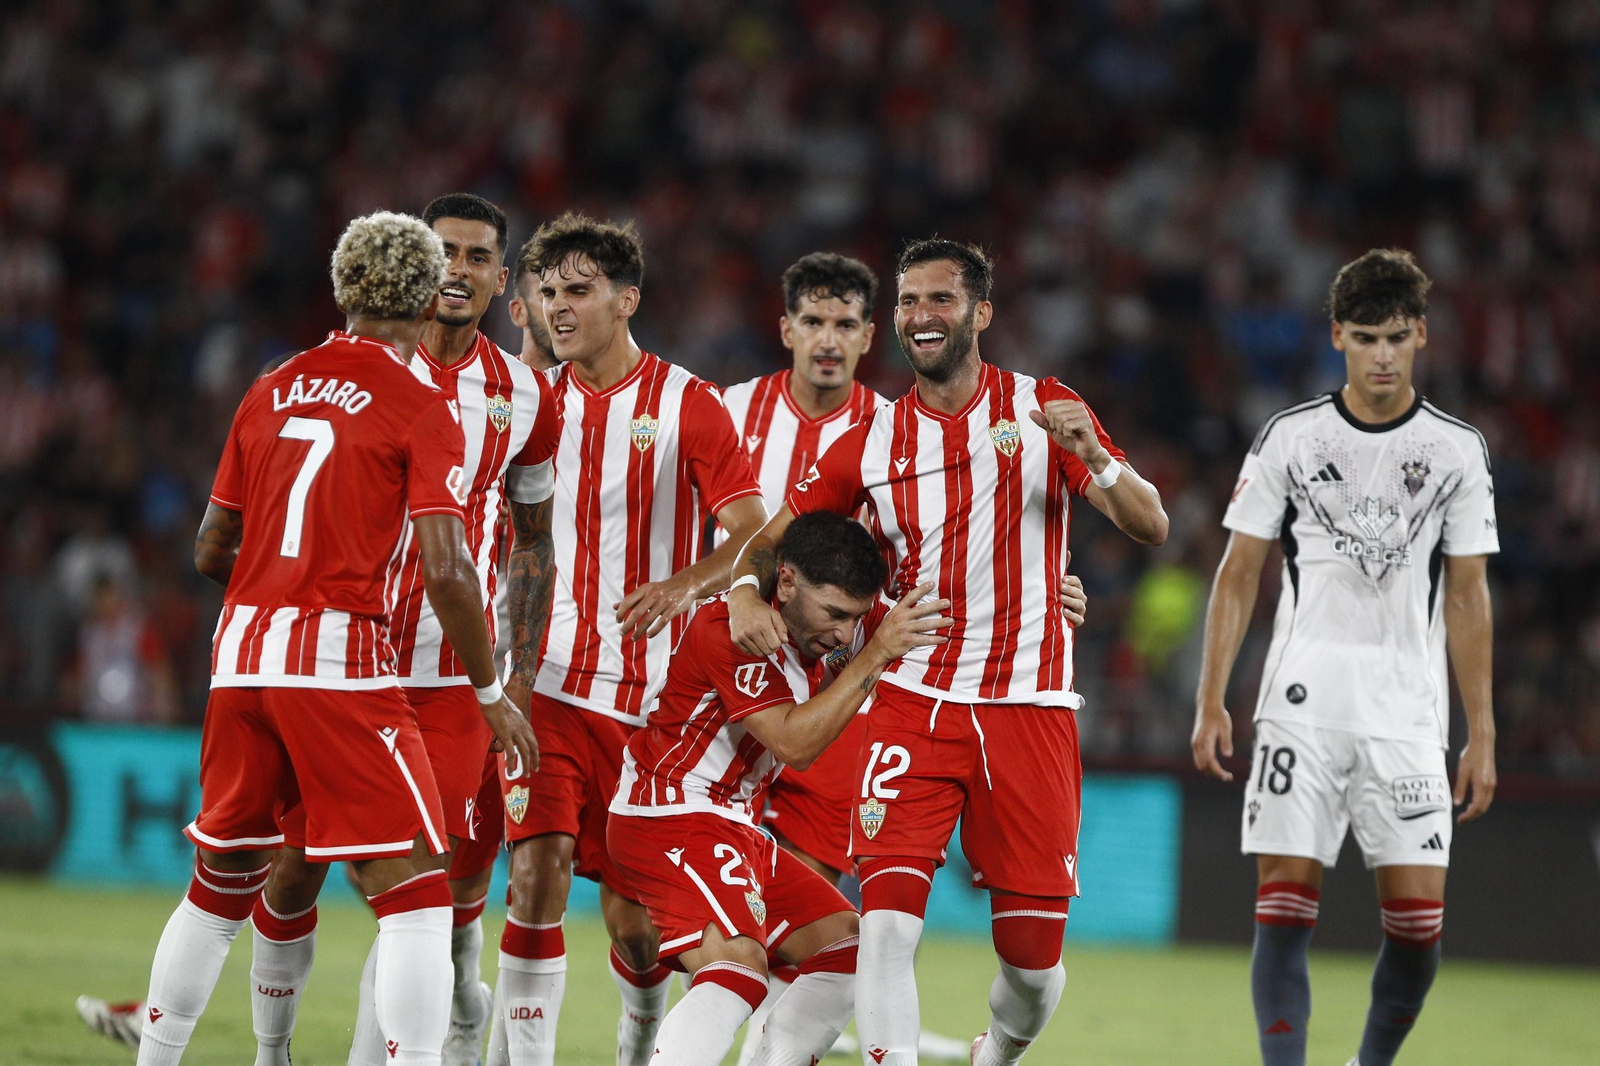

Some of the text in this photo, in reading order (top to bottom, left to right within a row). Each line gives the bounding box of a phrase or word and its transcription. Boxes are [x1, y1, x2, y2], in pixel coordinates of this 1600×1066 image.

[273, 374, 372, 415] LÁZARO
[277, 415, 335, 558] 7
[861, 742, 911, 799] 12
[1258, 745, 1296, 796] 18
[1400, 780, 1444, 793] AQUA
[1402, 793, 1444, 804] DEUS
[713, 843, 761, 896] 2
[258, 984, 295, 998] UDA
[509, 1007, 544, 1020] UDA
